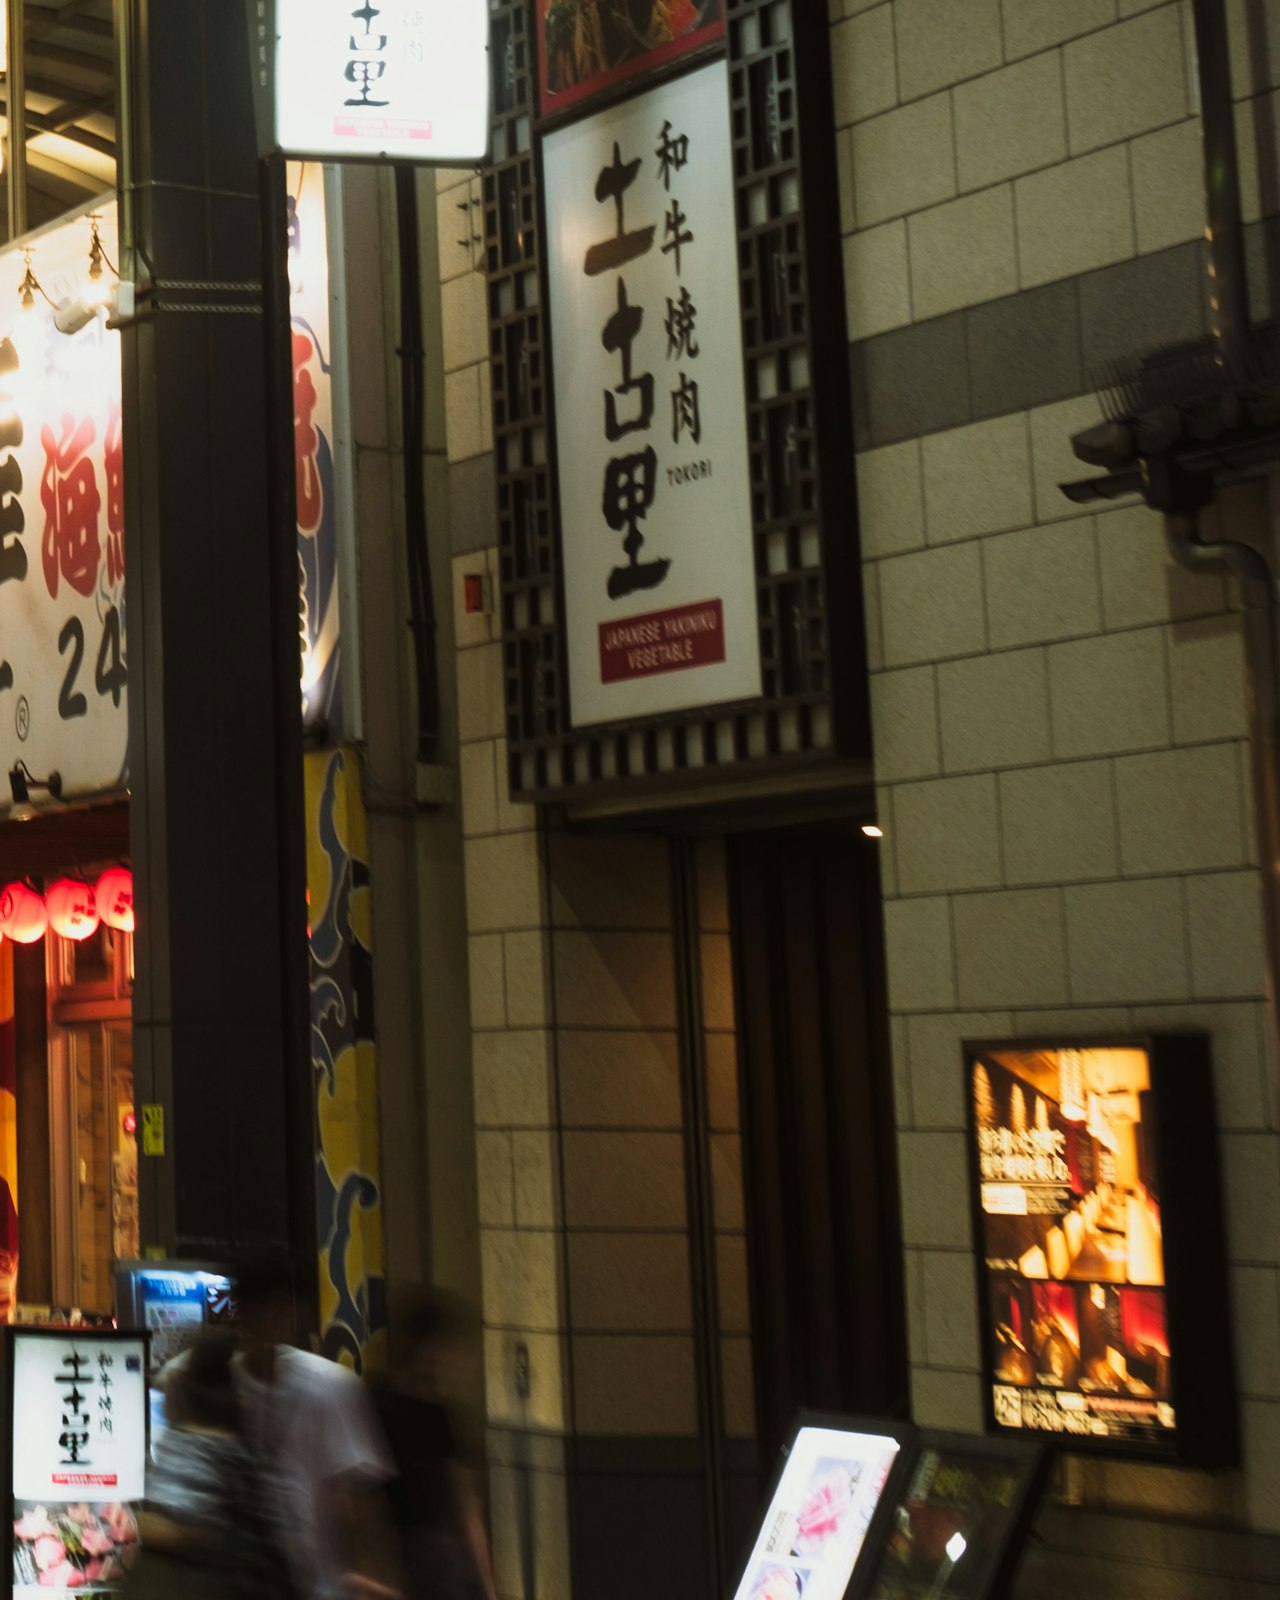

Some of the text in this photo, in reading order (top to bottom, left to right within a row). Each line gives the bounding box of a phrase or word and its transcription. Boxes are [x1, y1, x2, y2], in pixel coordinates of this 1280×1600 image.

[654, 120, 702, 445] 和牛焼肉
[584, 140, 672, 601] 土古里
[666, 458, 713, 487] TOKORI
[605, 608, 717, 651] JAPANESE YAKINIKU
[626, 640, 695, 670] VEGETABLE
[54, 1349, 95, 1466] 土古里
